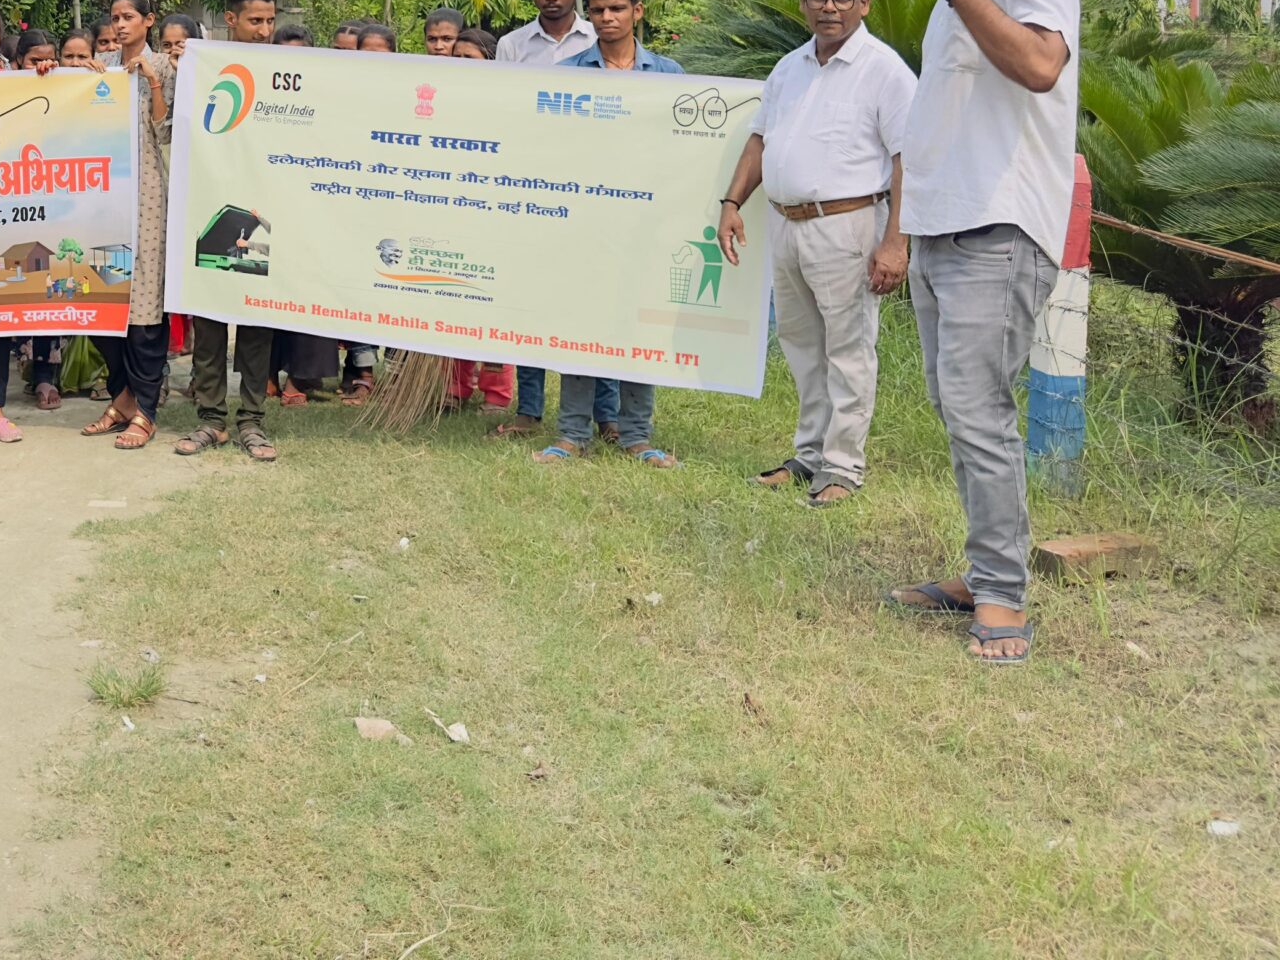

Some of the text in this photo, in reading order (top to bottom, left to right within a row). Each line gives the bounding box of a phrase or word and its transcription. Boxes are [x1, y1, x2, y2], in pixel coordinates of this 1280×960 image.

[272, 71, 302, 92] CSC
[254, 101, 315, 117] Digital India
[537, 91, 591, 116] NIC
[593, 107, 631, 116] Informatics
[253, 114, 273, 123] Power
[283, 117, 313, 127] Empower
[592, 112, 616, 120] Centre
[370, 130, 501, 153] भारत सरकार
[366, 162, 399, 175] और
[402, 167, 451, 181] सूचना
[456, 171, 490, 185] और
[585, 184, 654, 201] मंत्रालय
[310, 181, 351, 196] राष्ट्रीय
[497, 201, 522, 214] नई
[526, 203, 569, 218] दिल्ली
[12, 206, 46, 222] 2024
[409, 247, 464, 260] स्वच्छता
[408, 255, 495, 274] ही सेवा 2024
[22, 306, 98, 326] समस्तीपुर
[245, 295, 700, 367] kasturba Hemlata Mahila Samaj Kalyan Sansthan PVT. ITI
